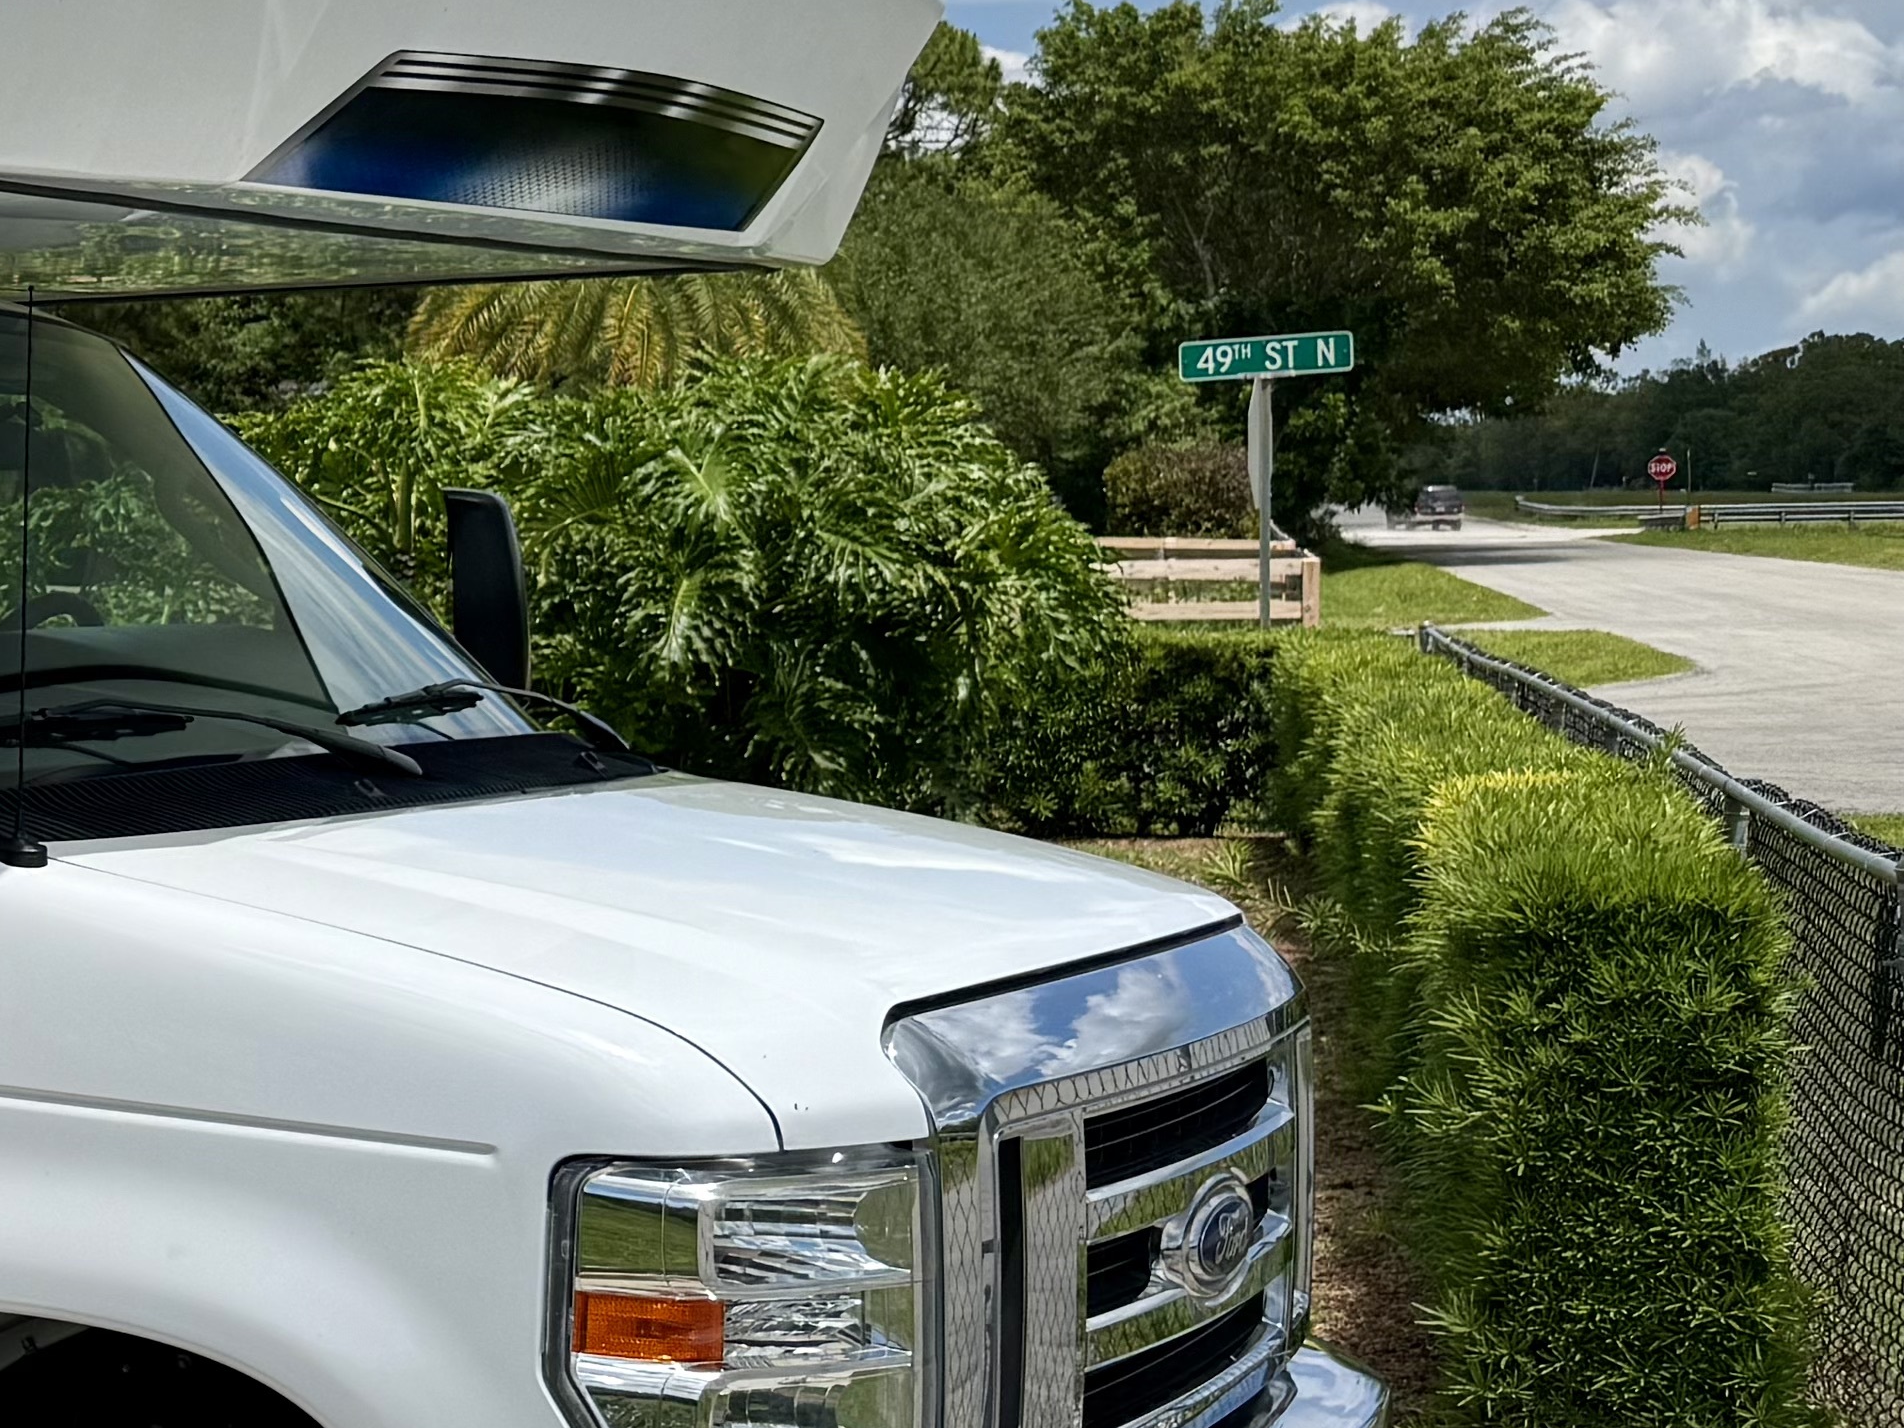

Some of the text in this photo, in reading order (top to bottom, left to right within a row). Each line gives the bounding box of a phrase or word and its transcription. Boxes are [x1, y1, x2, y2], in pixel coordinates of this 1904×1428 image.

[1196, 337, 1335, 375] 49TH ST N
[1650, 462, 1673, 473] STOP
[1215, 1209, 1248, 1264] Ford
